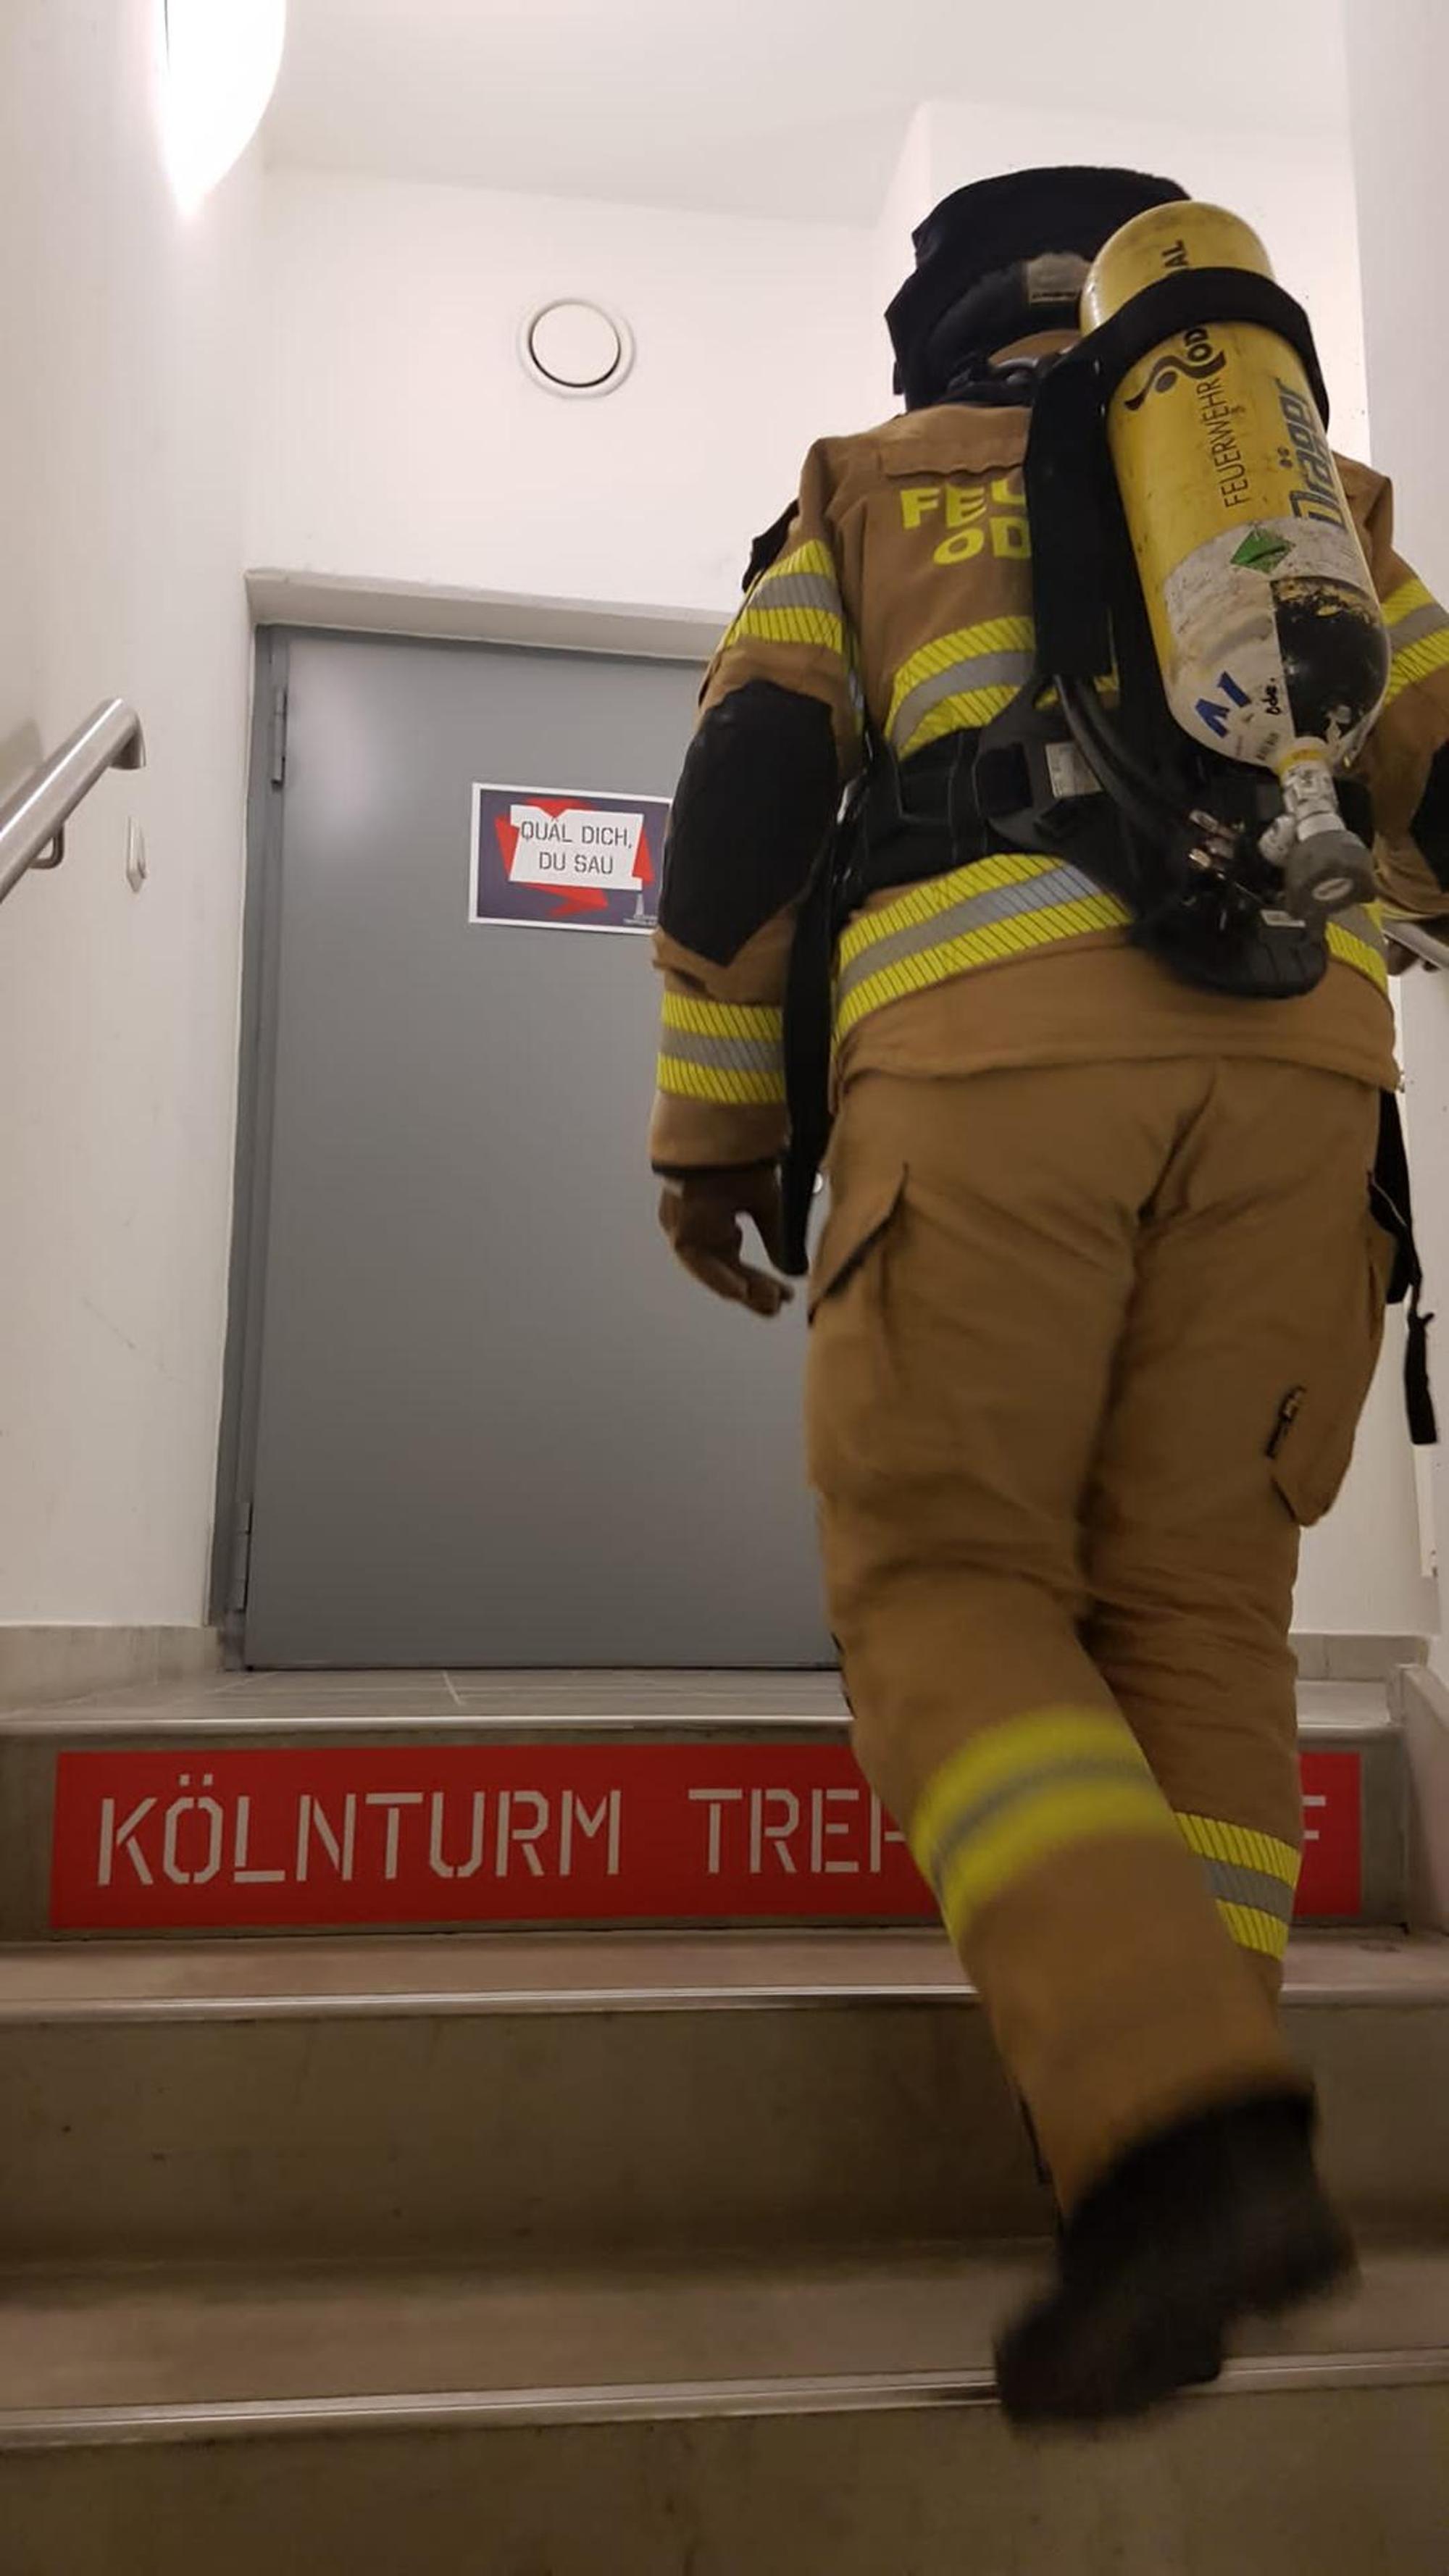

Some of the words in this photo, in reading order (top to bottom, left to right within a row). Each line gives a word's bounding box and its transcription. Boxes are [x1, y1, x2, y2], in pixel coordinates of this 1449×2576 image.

[1197, 377, 1251, 508] FEUERWEHR
[1274, 376, 1347, 530] Dräger
[538, 851, 566, 871] DU
[574, 853, 614, 875] SAU
[581, 825, 632, 849] DICH,
[96, 1773, 622, 1885] KÖLNTURM
